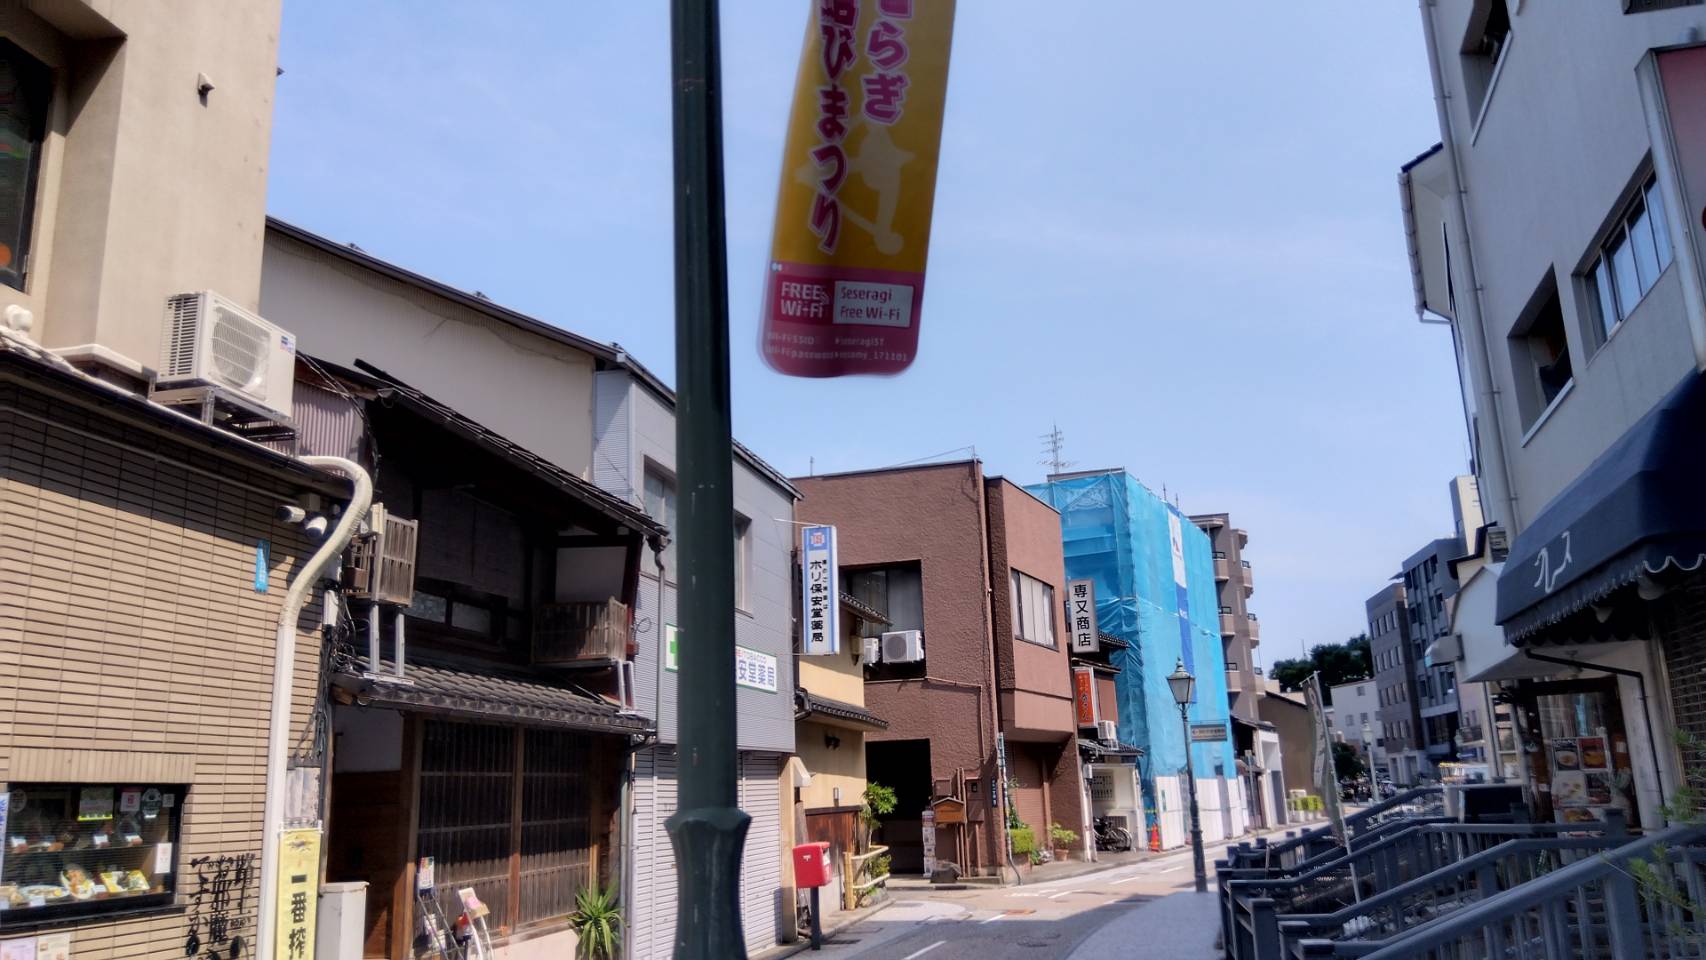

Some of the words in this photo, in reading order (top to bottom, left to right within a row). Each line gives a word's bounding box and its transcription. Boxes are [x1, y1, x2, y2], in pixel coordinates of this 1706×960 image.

[781, 281, 821, 301] FREE
[840, 286, 892, 303] Seseragi
[780, 299, 823, 318] Wi-Fi
[840, 306, 863, 319] Free
[866, 307, 900, 320] Wi-Fi
[810, 560, 823, 642] ホリ保安堂薬局
[1073, 583, 1091, 647] 専又商店
